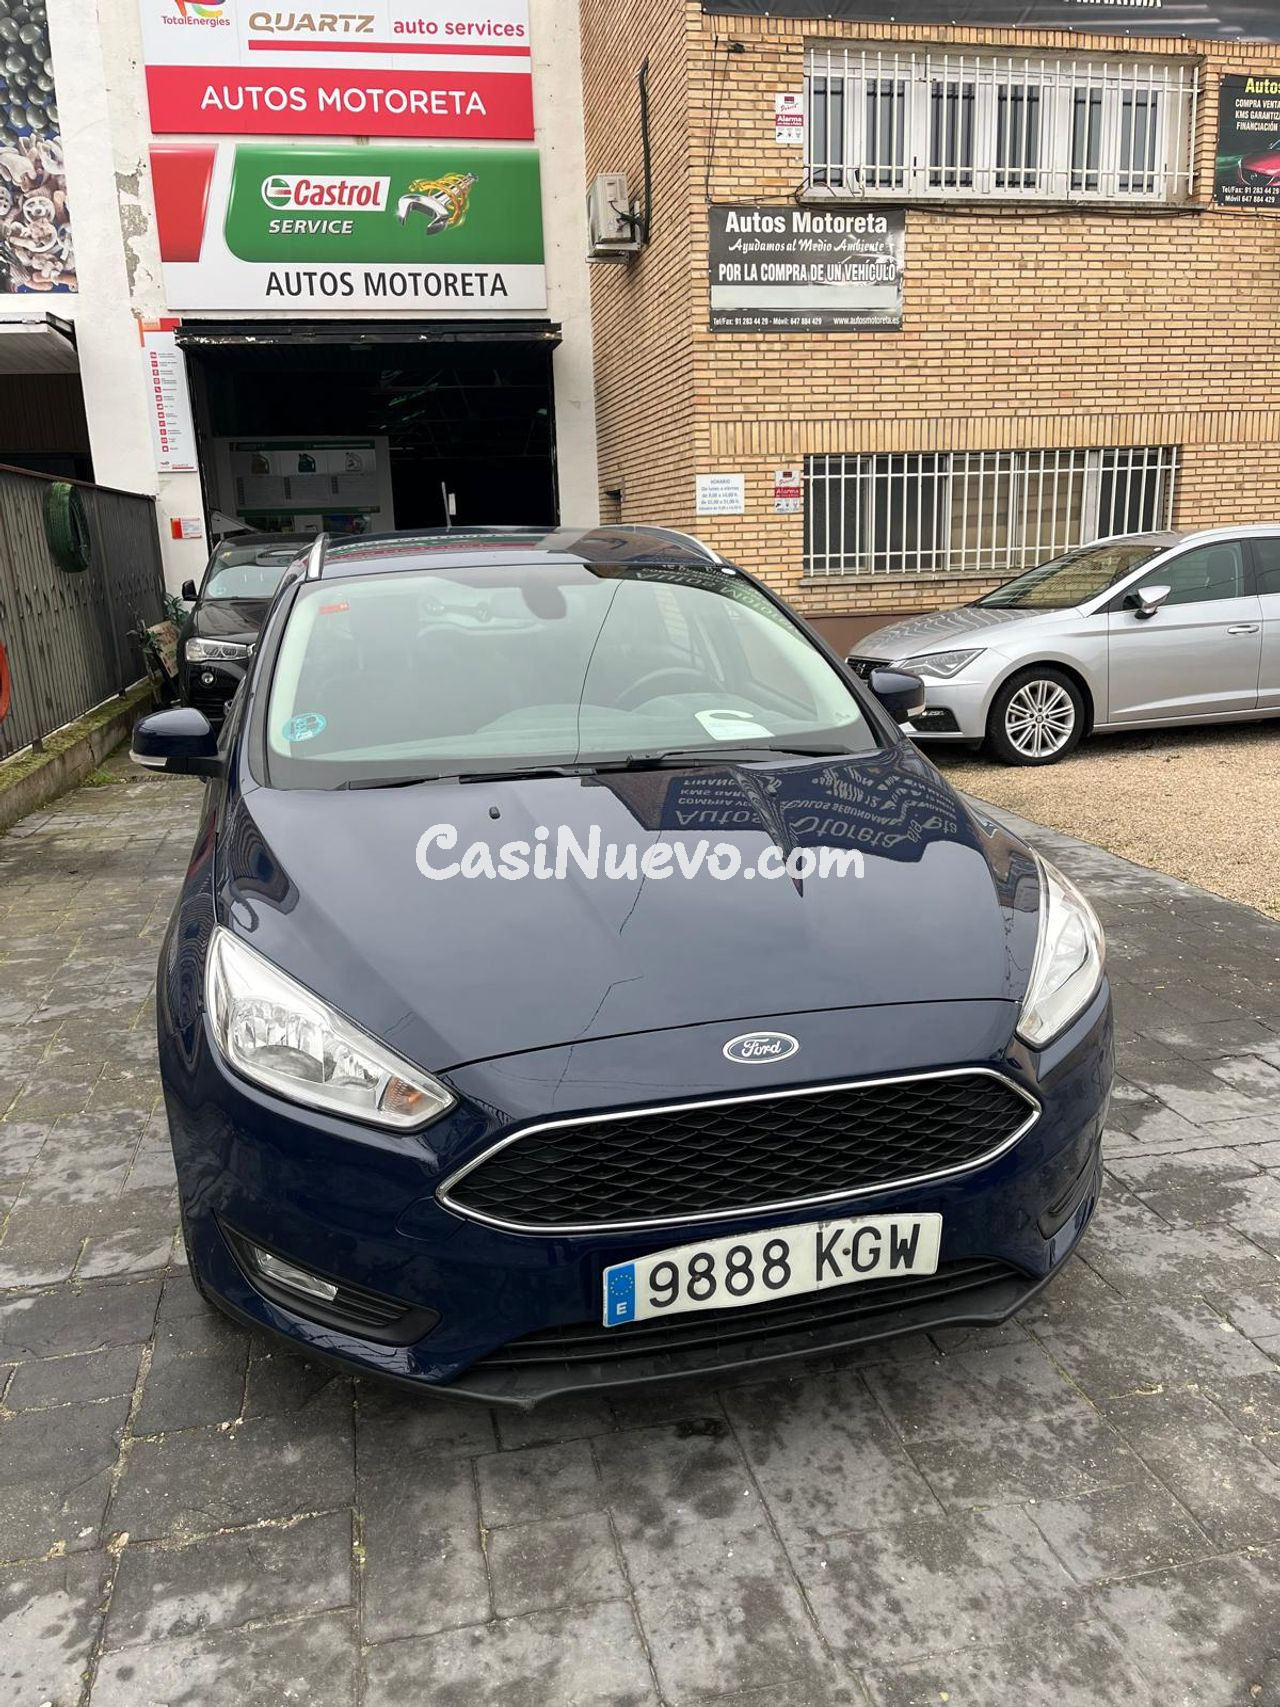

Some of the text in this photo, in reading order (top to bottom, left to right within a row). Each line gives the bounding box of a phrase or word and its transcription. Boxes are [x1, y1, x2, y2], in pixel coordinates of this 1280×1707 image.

[161, 15, 231, 28] TotalEnergies
[248, 11, 375, 34] QUARTZ
[393, 18, 525, 37] auto services
[200, 85, 487, 116] AUTOS MOTORETA
[1235, 98, 1261, 108] COMPRA
[1235, 110, 1280, 120] KMS GARANTIZ
[1236, 120, 1278, 132] FINANCIACIÓN
[293, 179, 381, 206] Castrol
[268, 219, 354, 235] SERVICE
[725, 211, 887, 234] Autos Motoreta
[728, 238, 885, 254] Ayudamos al Medio Ambiente
[718, 259, 896, 282] POR LA COMPRA DE UN VEHÍCULO
[265, 271, 509, 298] AUTOS MOTORETA
[833, 316, 900, 325] www.autosmotoreta.es
[741, 1038, 782, 1057] Ford
[616, 1223, 921, 1315] E 9888 KGW
